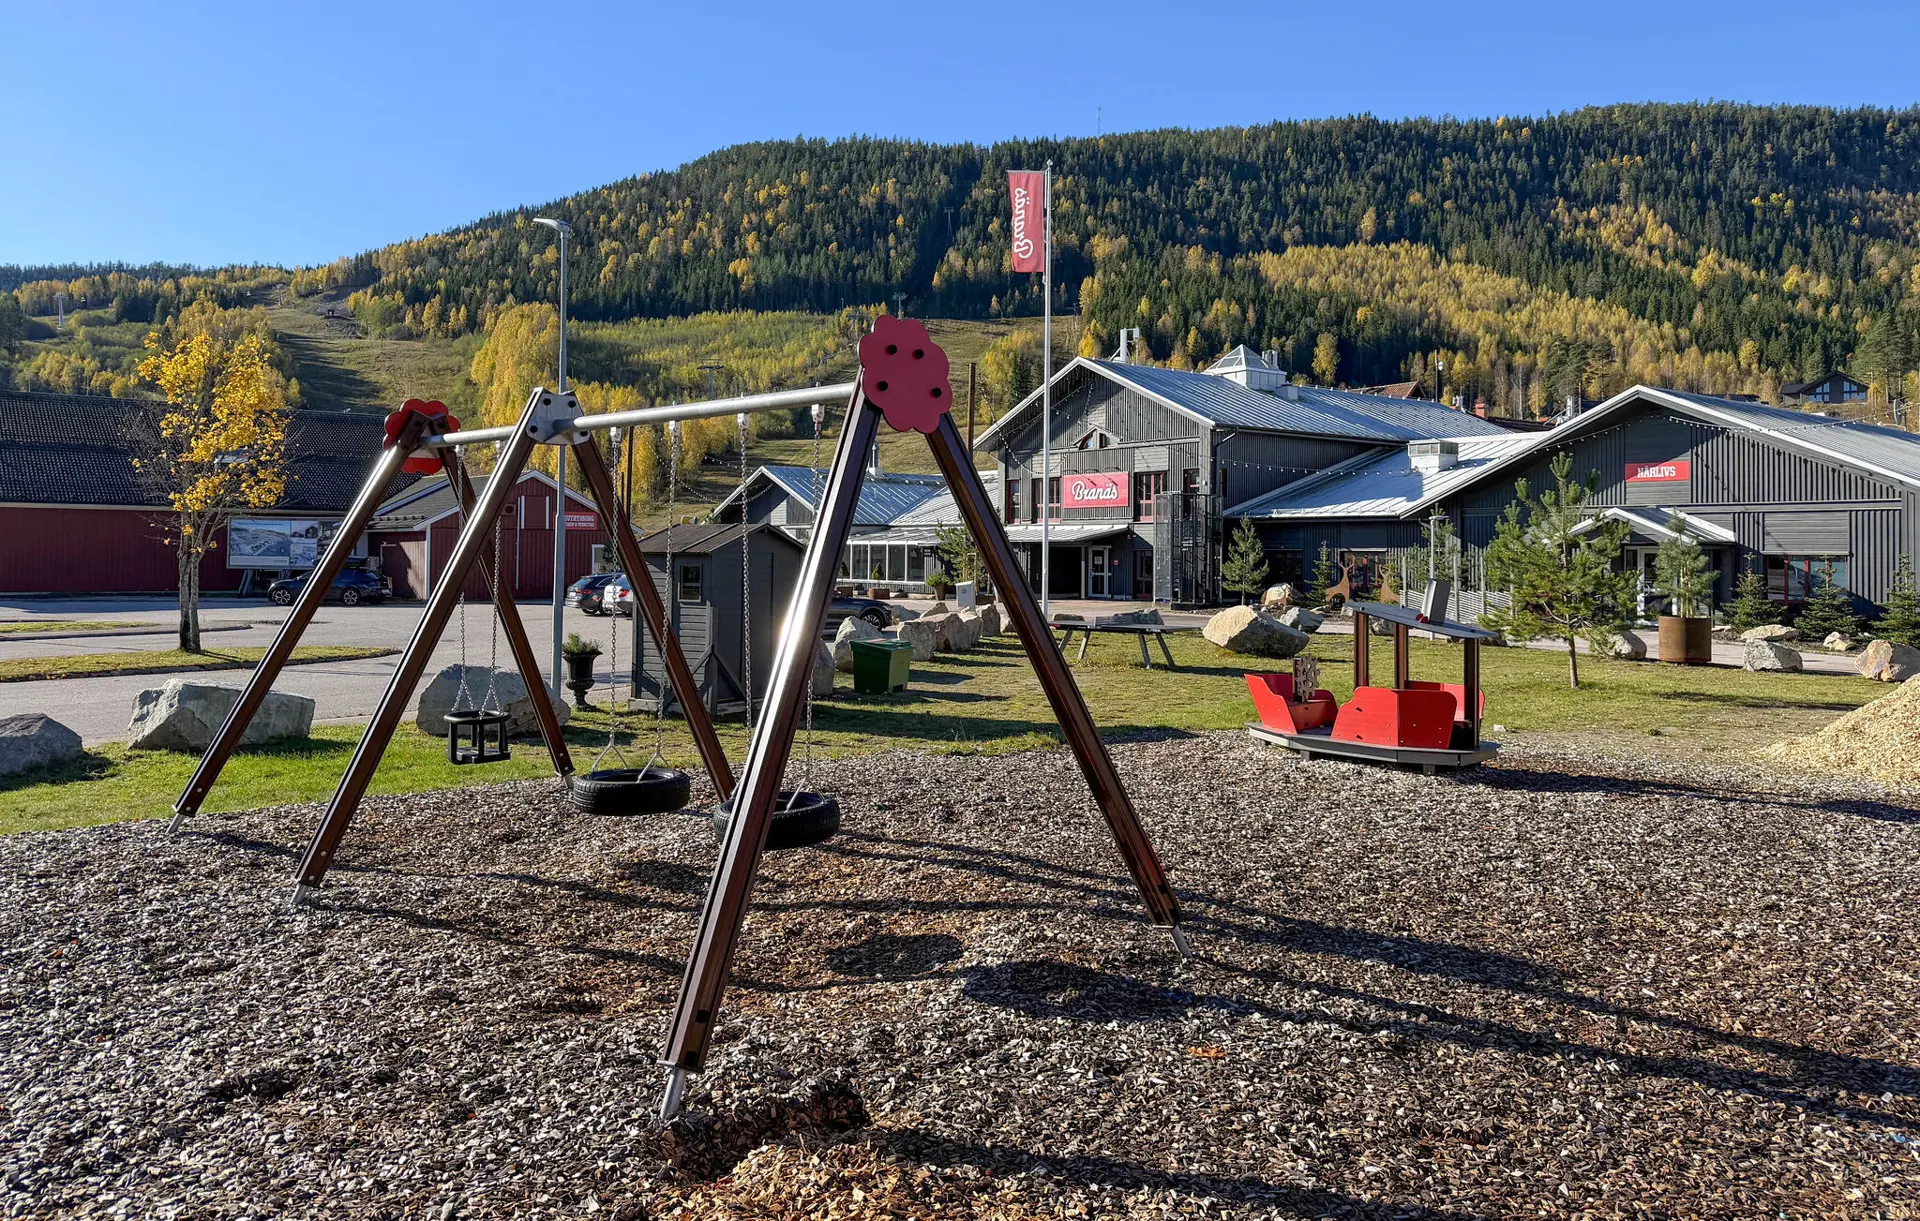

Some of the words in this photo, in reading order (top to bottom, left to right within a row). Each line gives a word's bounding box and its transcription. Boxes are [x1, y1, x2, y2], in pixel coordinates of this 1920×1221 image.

[1014, 187, 1034, 259] Branäs
[1637, 465, 1676, 478] NÄRLIVS
[1071, 480, 1118, 501] Branäs
